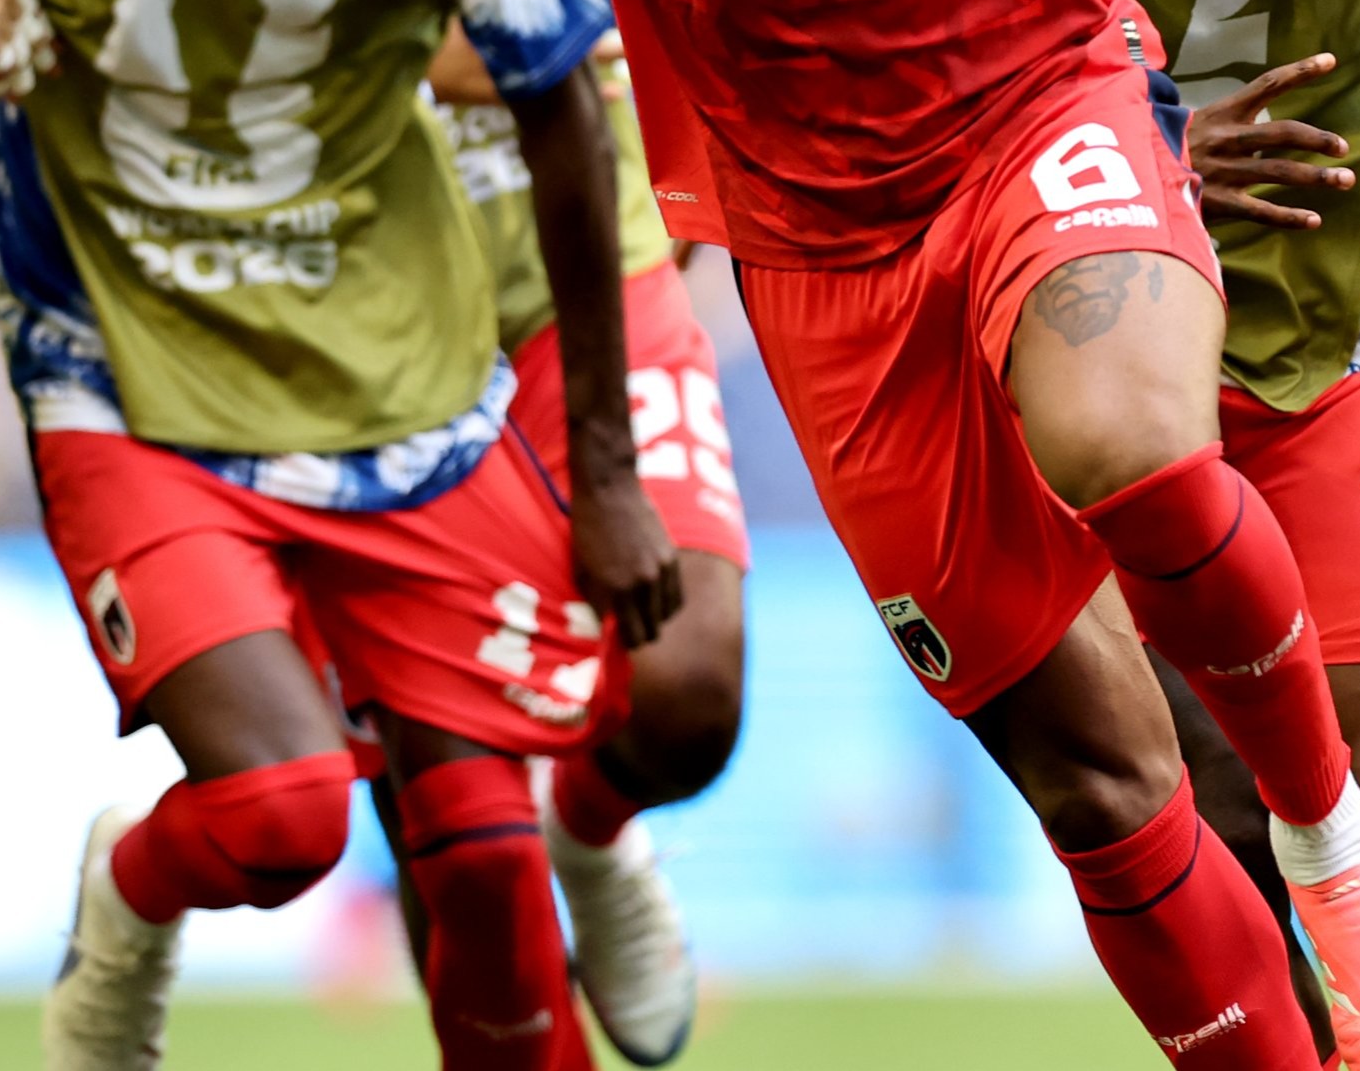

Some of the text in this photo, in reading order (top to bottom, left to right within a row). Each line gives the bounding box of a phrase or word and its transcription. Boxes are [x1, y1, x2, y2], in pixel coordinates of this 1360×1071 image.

[1029, 122, 1142, 212] 6
[880, 599, 911, 620] FCF
[1151, 1001, 1247, 1054] apelli
